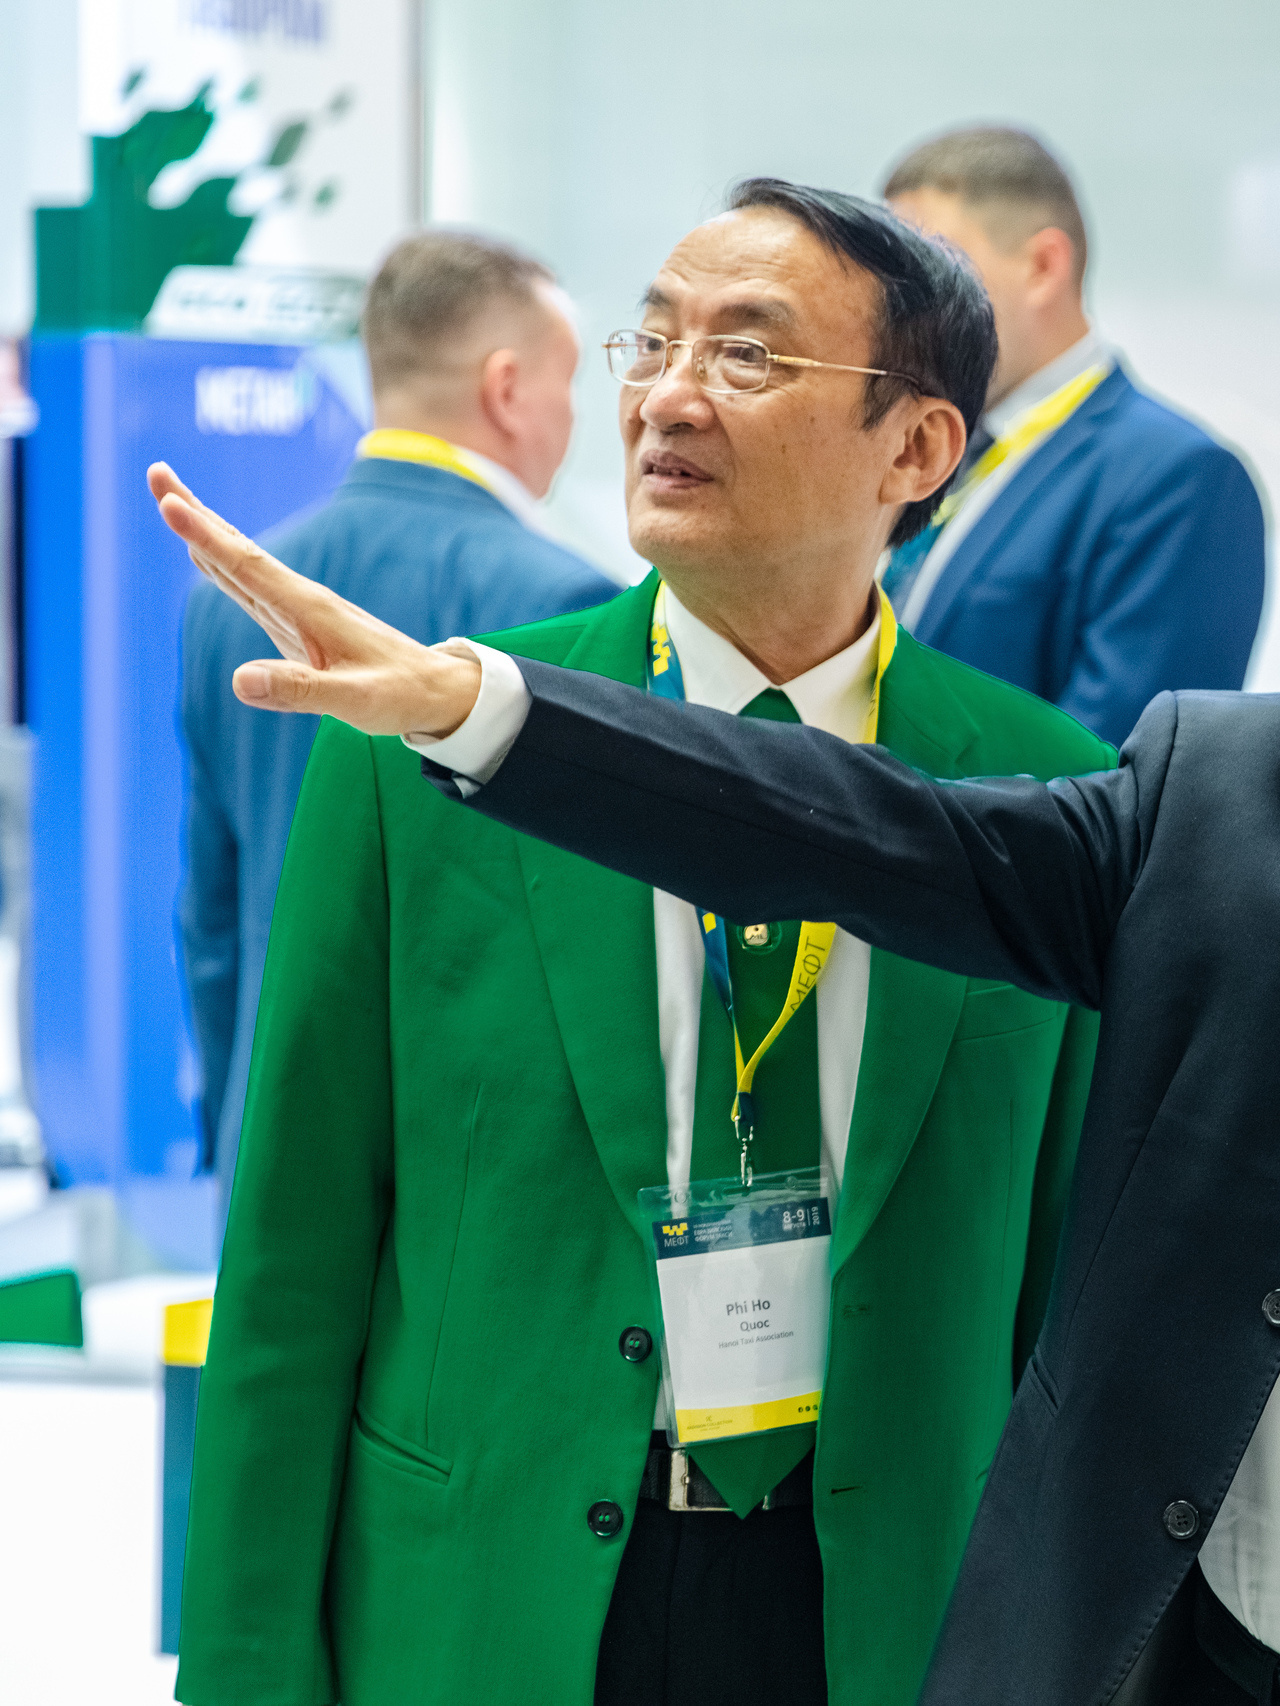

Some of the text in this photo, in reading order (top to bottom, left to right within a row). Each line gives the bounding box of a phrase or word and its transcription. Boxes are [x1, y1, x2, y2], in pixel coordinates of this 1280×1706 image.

[790, 935, 826, 1011] МЕФТ
[782, 1208, 805, 1224] 8-9
[811, 1206, 820, 1225] 2019
[664, 1235, 689, 1248] МЕФТ
[726, 1299, 771, 1316] Phi Ho
[740, 1319, 770, 1332] Quoc
[718, 1330, 794, 1349] Hanoi Taxi Association
